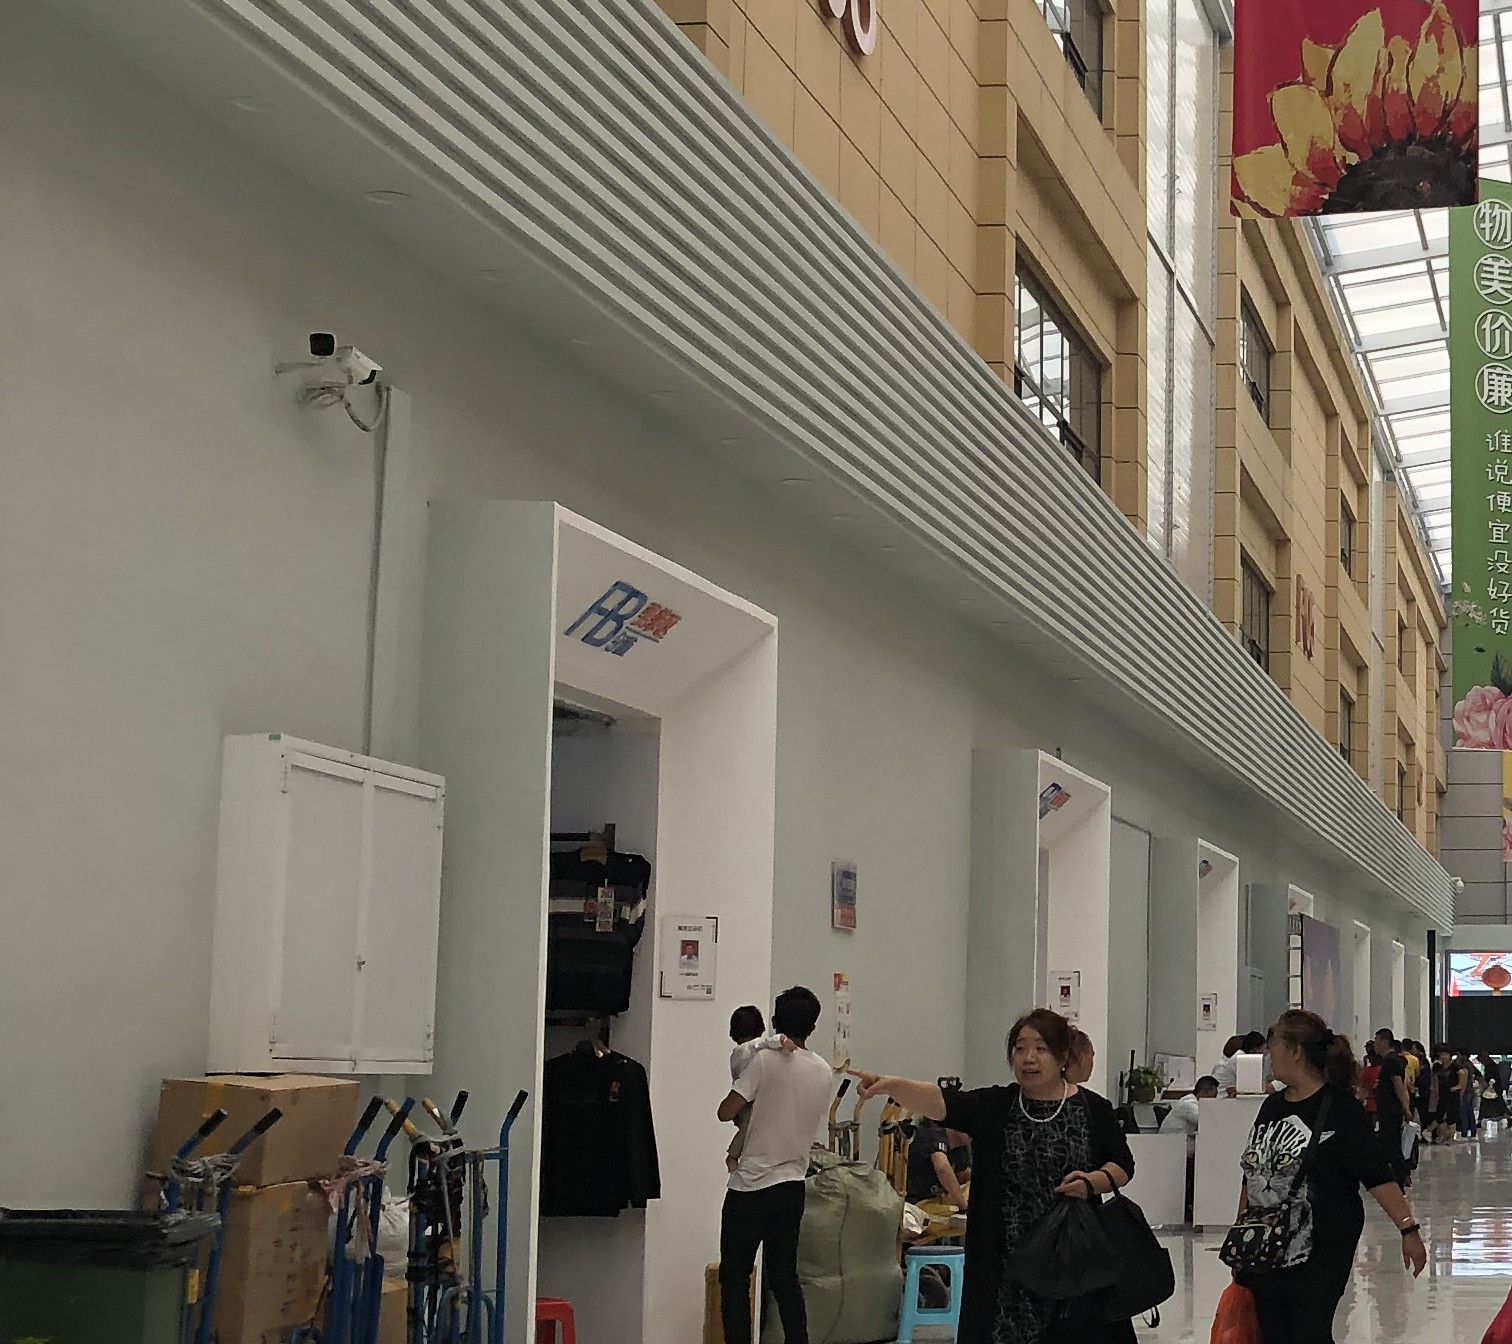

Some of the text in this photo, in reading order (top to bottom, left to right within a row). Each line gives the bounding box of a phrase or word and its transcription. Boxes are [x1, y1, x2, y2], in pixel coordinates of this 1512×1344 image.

[1485, 429, 1512, 635] 谁说便宜没好货
[564, 580, 649, 647] FB
